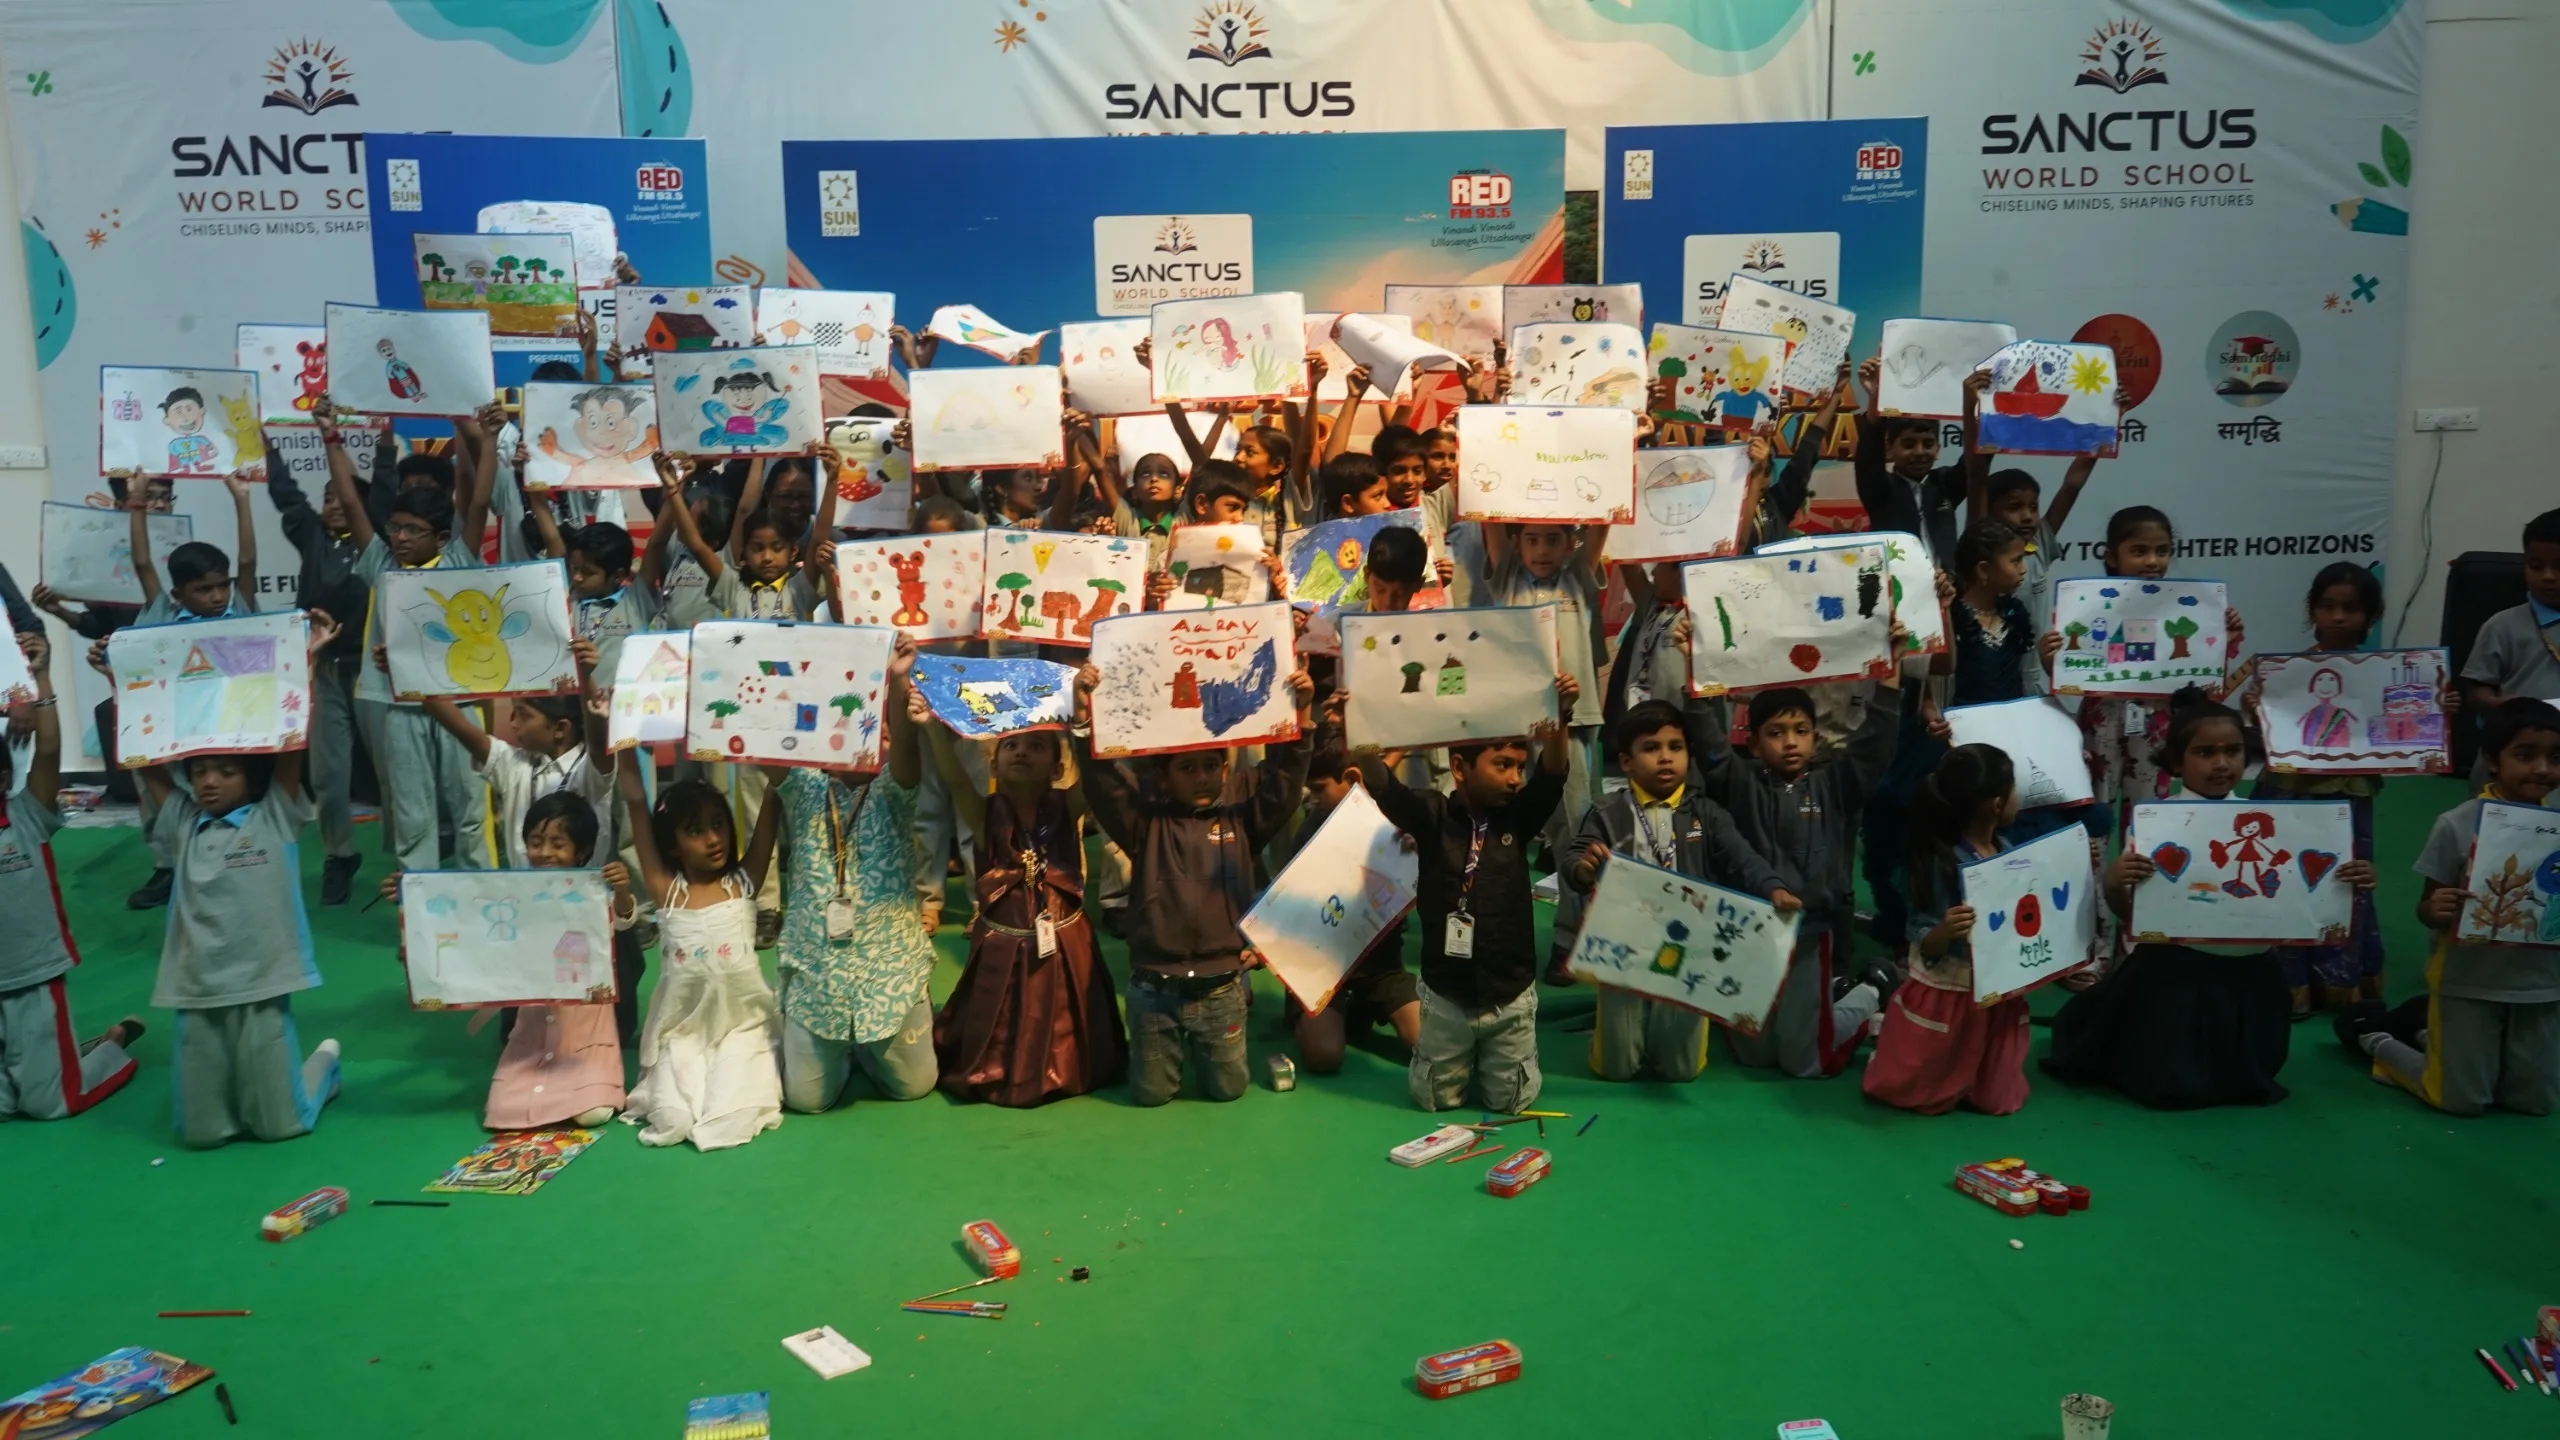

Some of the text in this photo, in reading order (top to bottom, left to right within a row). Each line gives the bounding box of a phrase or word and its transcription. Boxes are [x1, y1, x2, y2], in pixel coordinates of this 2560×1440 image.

[1106, 82, 1355, 119] SANCTUS
[1982, 109, 2257, 154] SANCTUS
[172, 131, 452, 177] SANCT
[1859, 147, 1901, 170] RED
[639, 167, 682, 190] RED
[1626, 180, 1650, 191] SUN
[1982, 163, 2255, 190] WORLD SCHOOL
[178, 190, 299, 213] WORLD
[392, 191, 420, 202] SUN
[1451, 175, 1512, 206] RED
[1449, 207, 1512, 219] FM 93.5
[1981, 194, 2254, 213] CHISELING MINDS, SHAPING FUTURES
[180, 219, 369, 237] CHISELING MINDS, SHAPI
[824, 211, 857, 225] SUN
[1112, 262, 1242, 283] SANCTUS
[1113, 288, 1169, 302] WORLD
[2118, 357, 2149, 369] kriti
[2219, 351, 2291, 365] Samriddhi
[1942, 423, 1964, 448] वि
[2217, 415, 2283, 446] समृद्धि
[2245, 533, 2374, 558] HORIZONS
